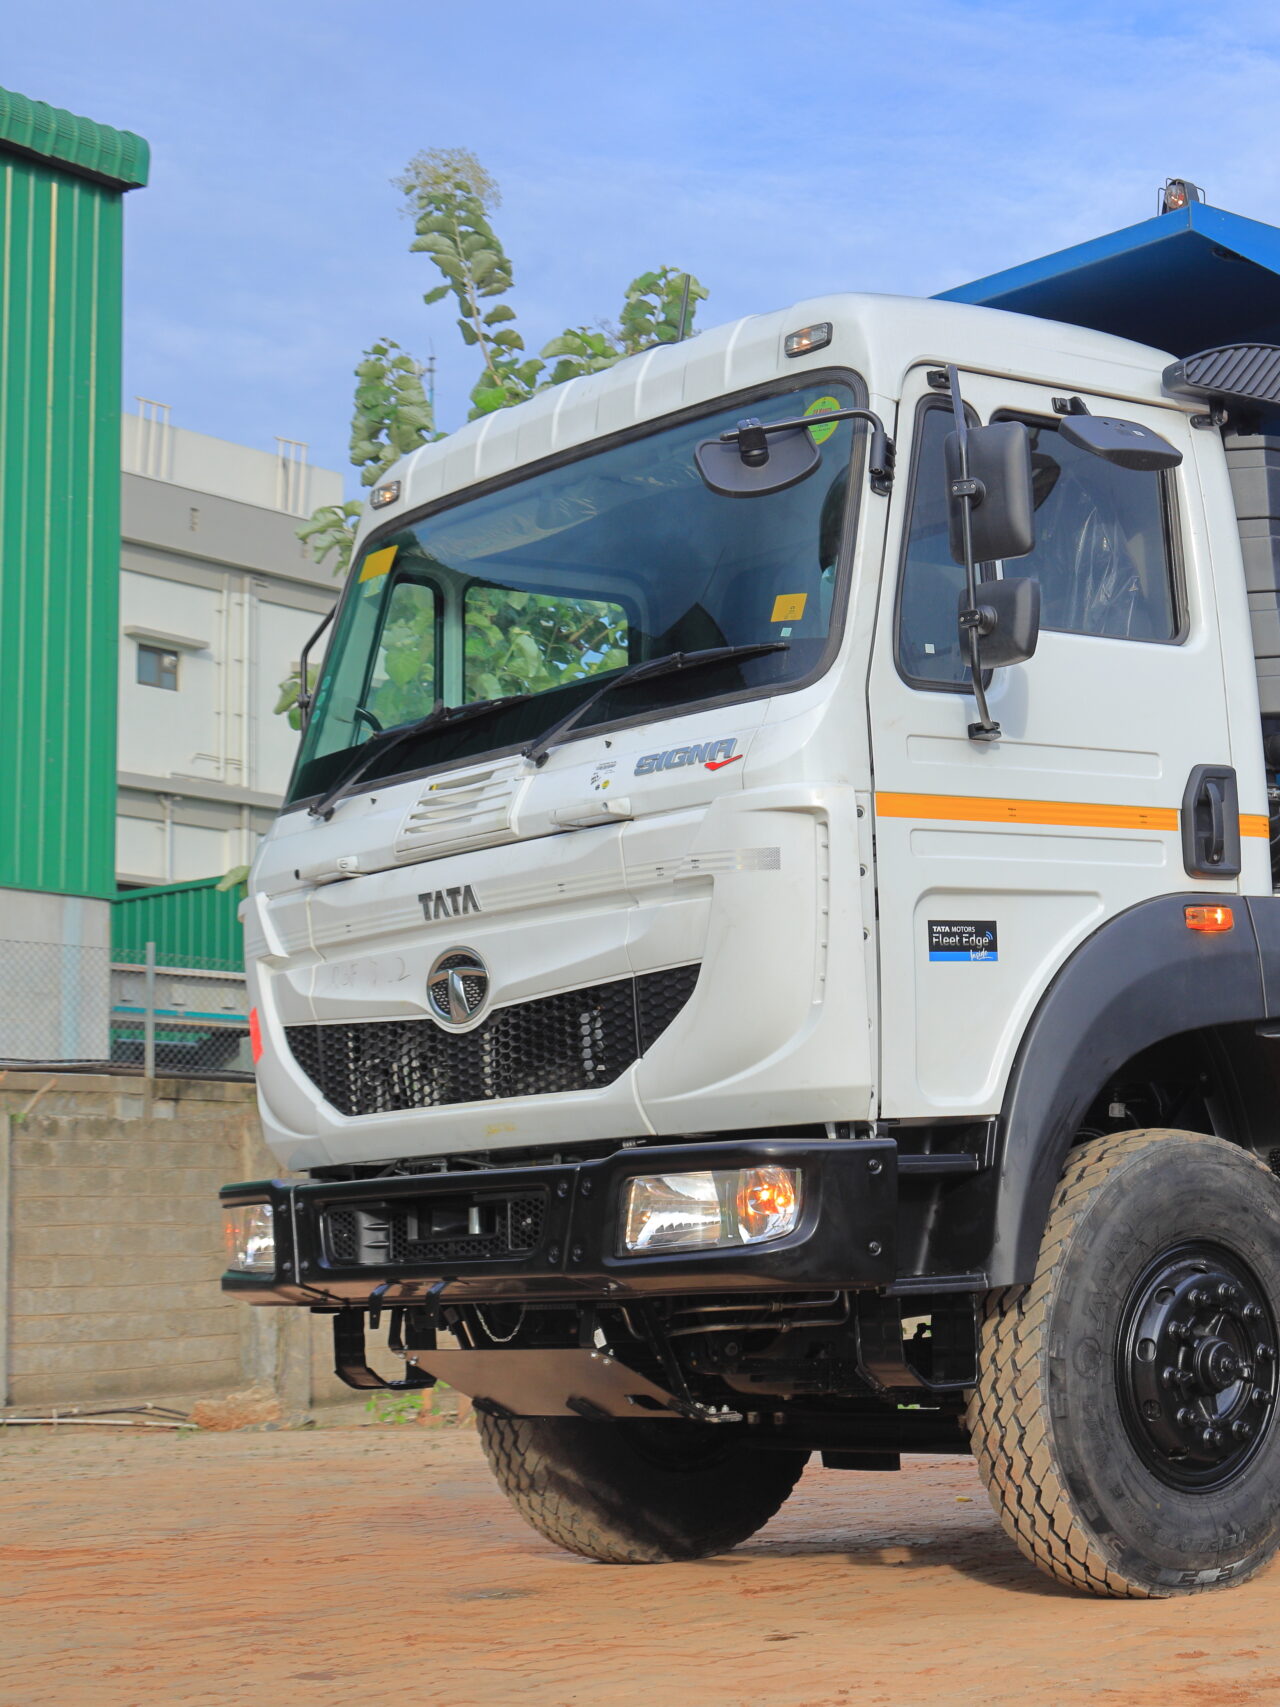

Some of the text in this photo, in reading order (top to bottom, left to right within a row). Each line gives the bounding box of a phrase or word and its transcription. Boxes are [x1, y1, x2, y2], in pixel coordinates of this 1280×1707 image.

[634, 738, 737, 777] SIGNA
[418, 884, 482, 921] TATA
[932, 934, 989, 949] Fleet Edge
